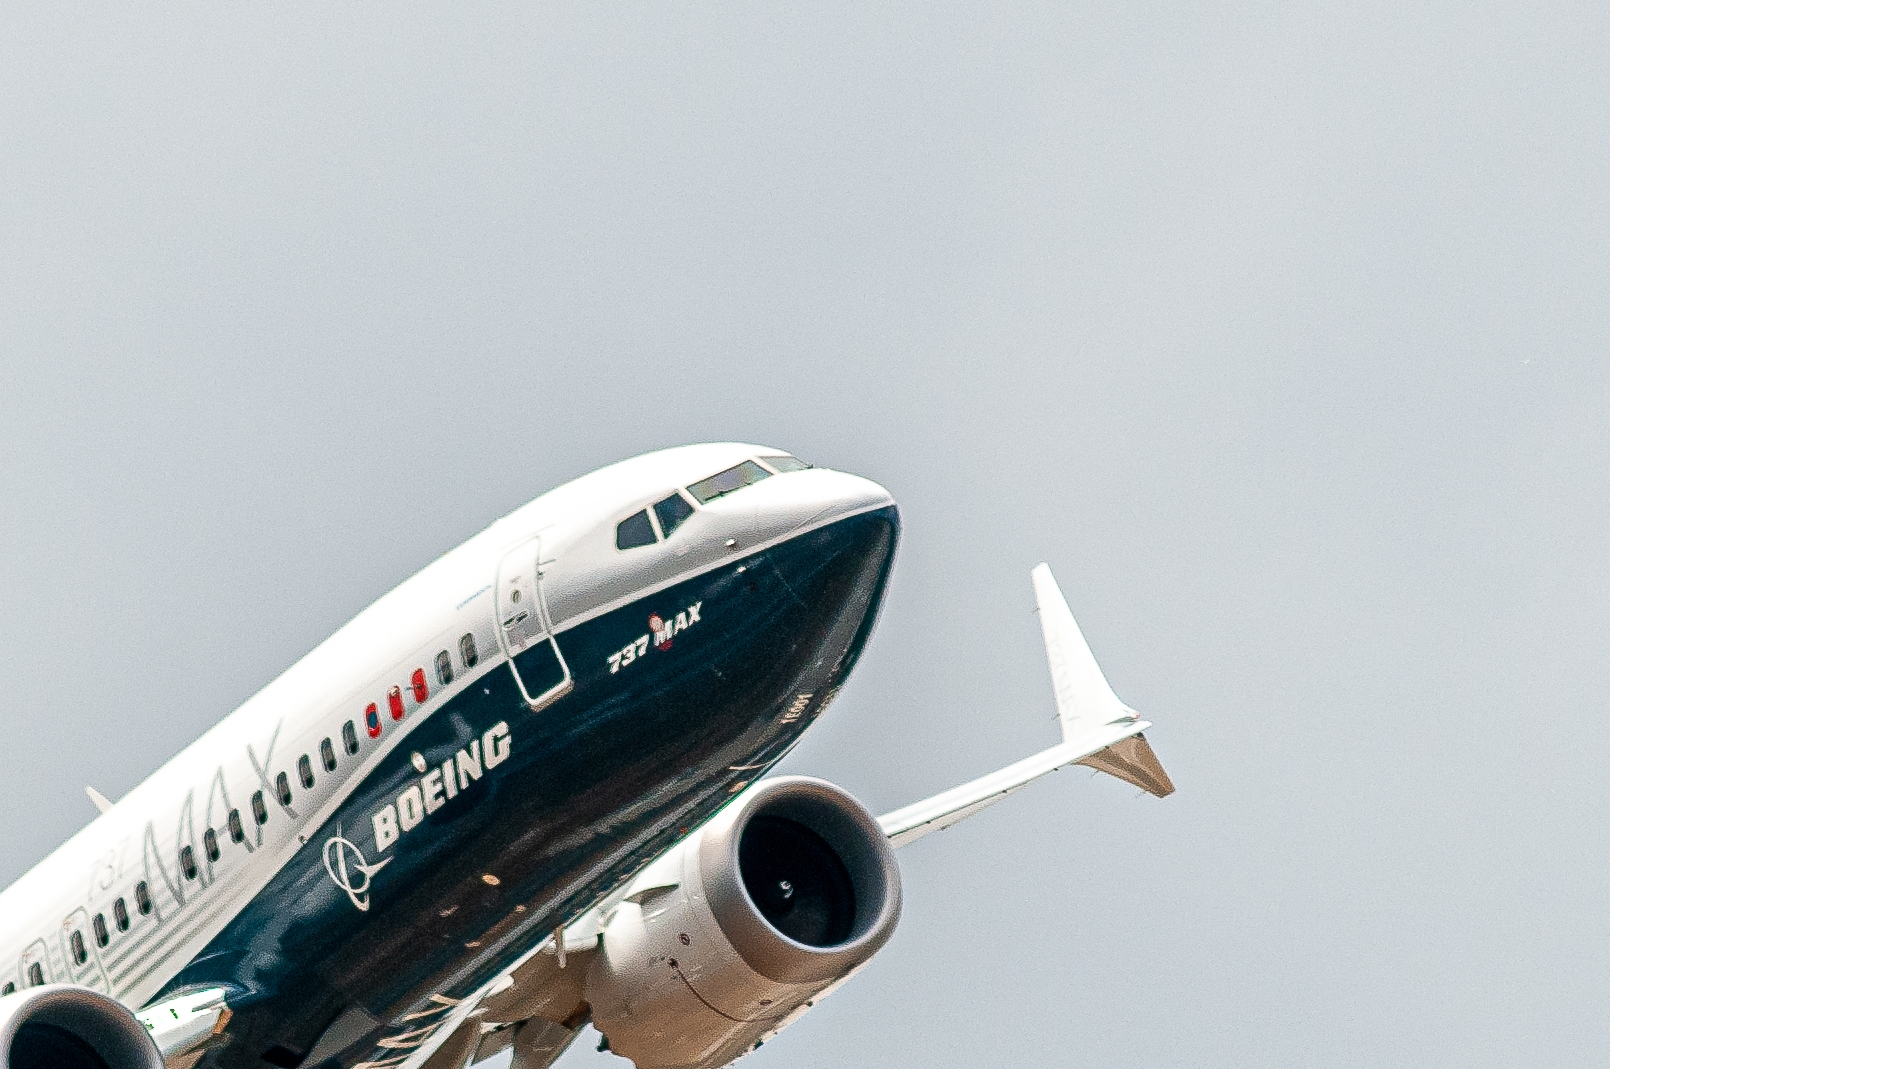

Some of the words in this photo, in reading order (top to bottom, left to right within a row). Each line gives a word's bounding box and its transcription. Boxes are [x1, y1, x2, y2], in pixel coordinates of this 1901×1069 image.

[606, 633, 649, 674] 737
[653, 601, 703, 647] MAX
[142, 716, 300, 925] MAX
[371, 720, 512, 852] BOEING
